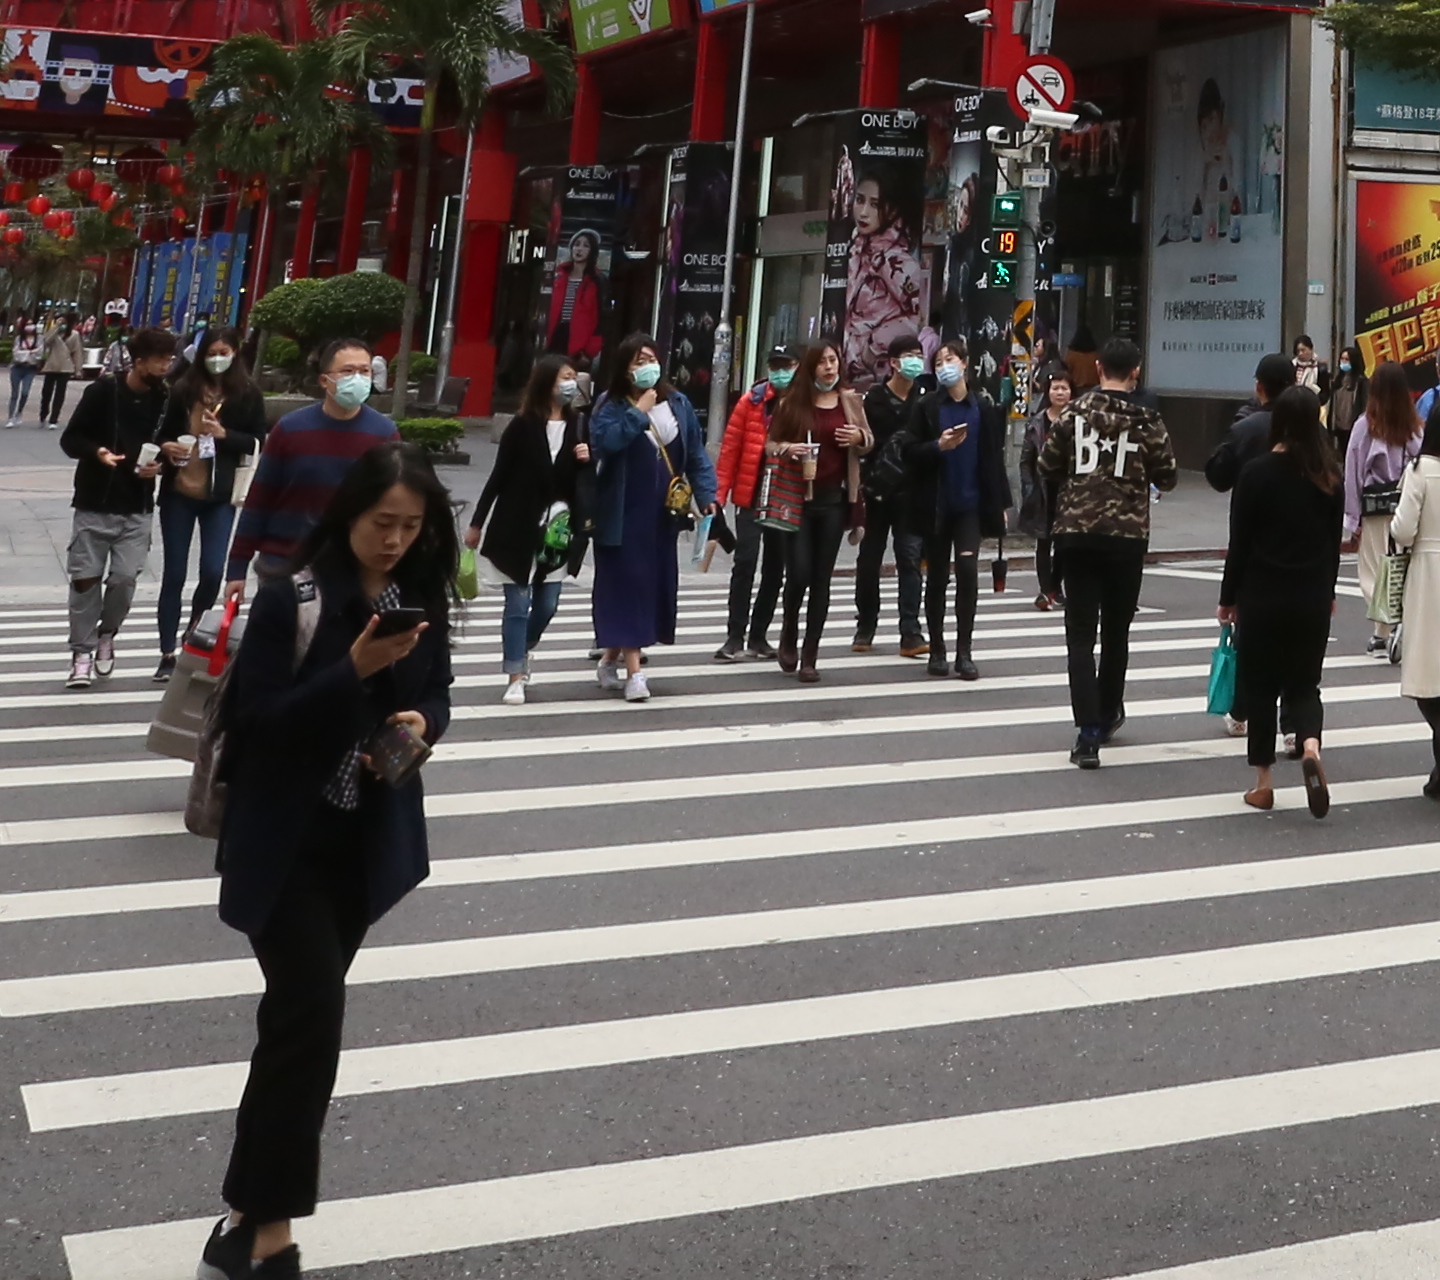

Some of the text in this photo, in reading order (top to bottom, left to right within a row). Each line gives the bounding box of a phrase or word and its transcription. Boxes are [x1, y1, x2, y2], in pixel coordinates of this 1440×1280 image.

[861, 113, 920, 129] ONE BOY
[569, 168, 590, 179] ONE
[999, 232, 1014, 253] 19
[684, 254, 727, 267] ONE BO
